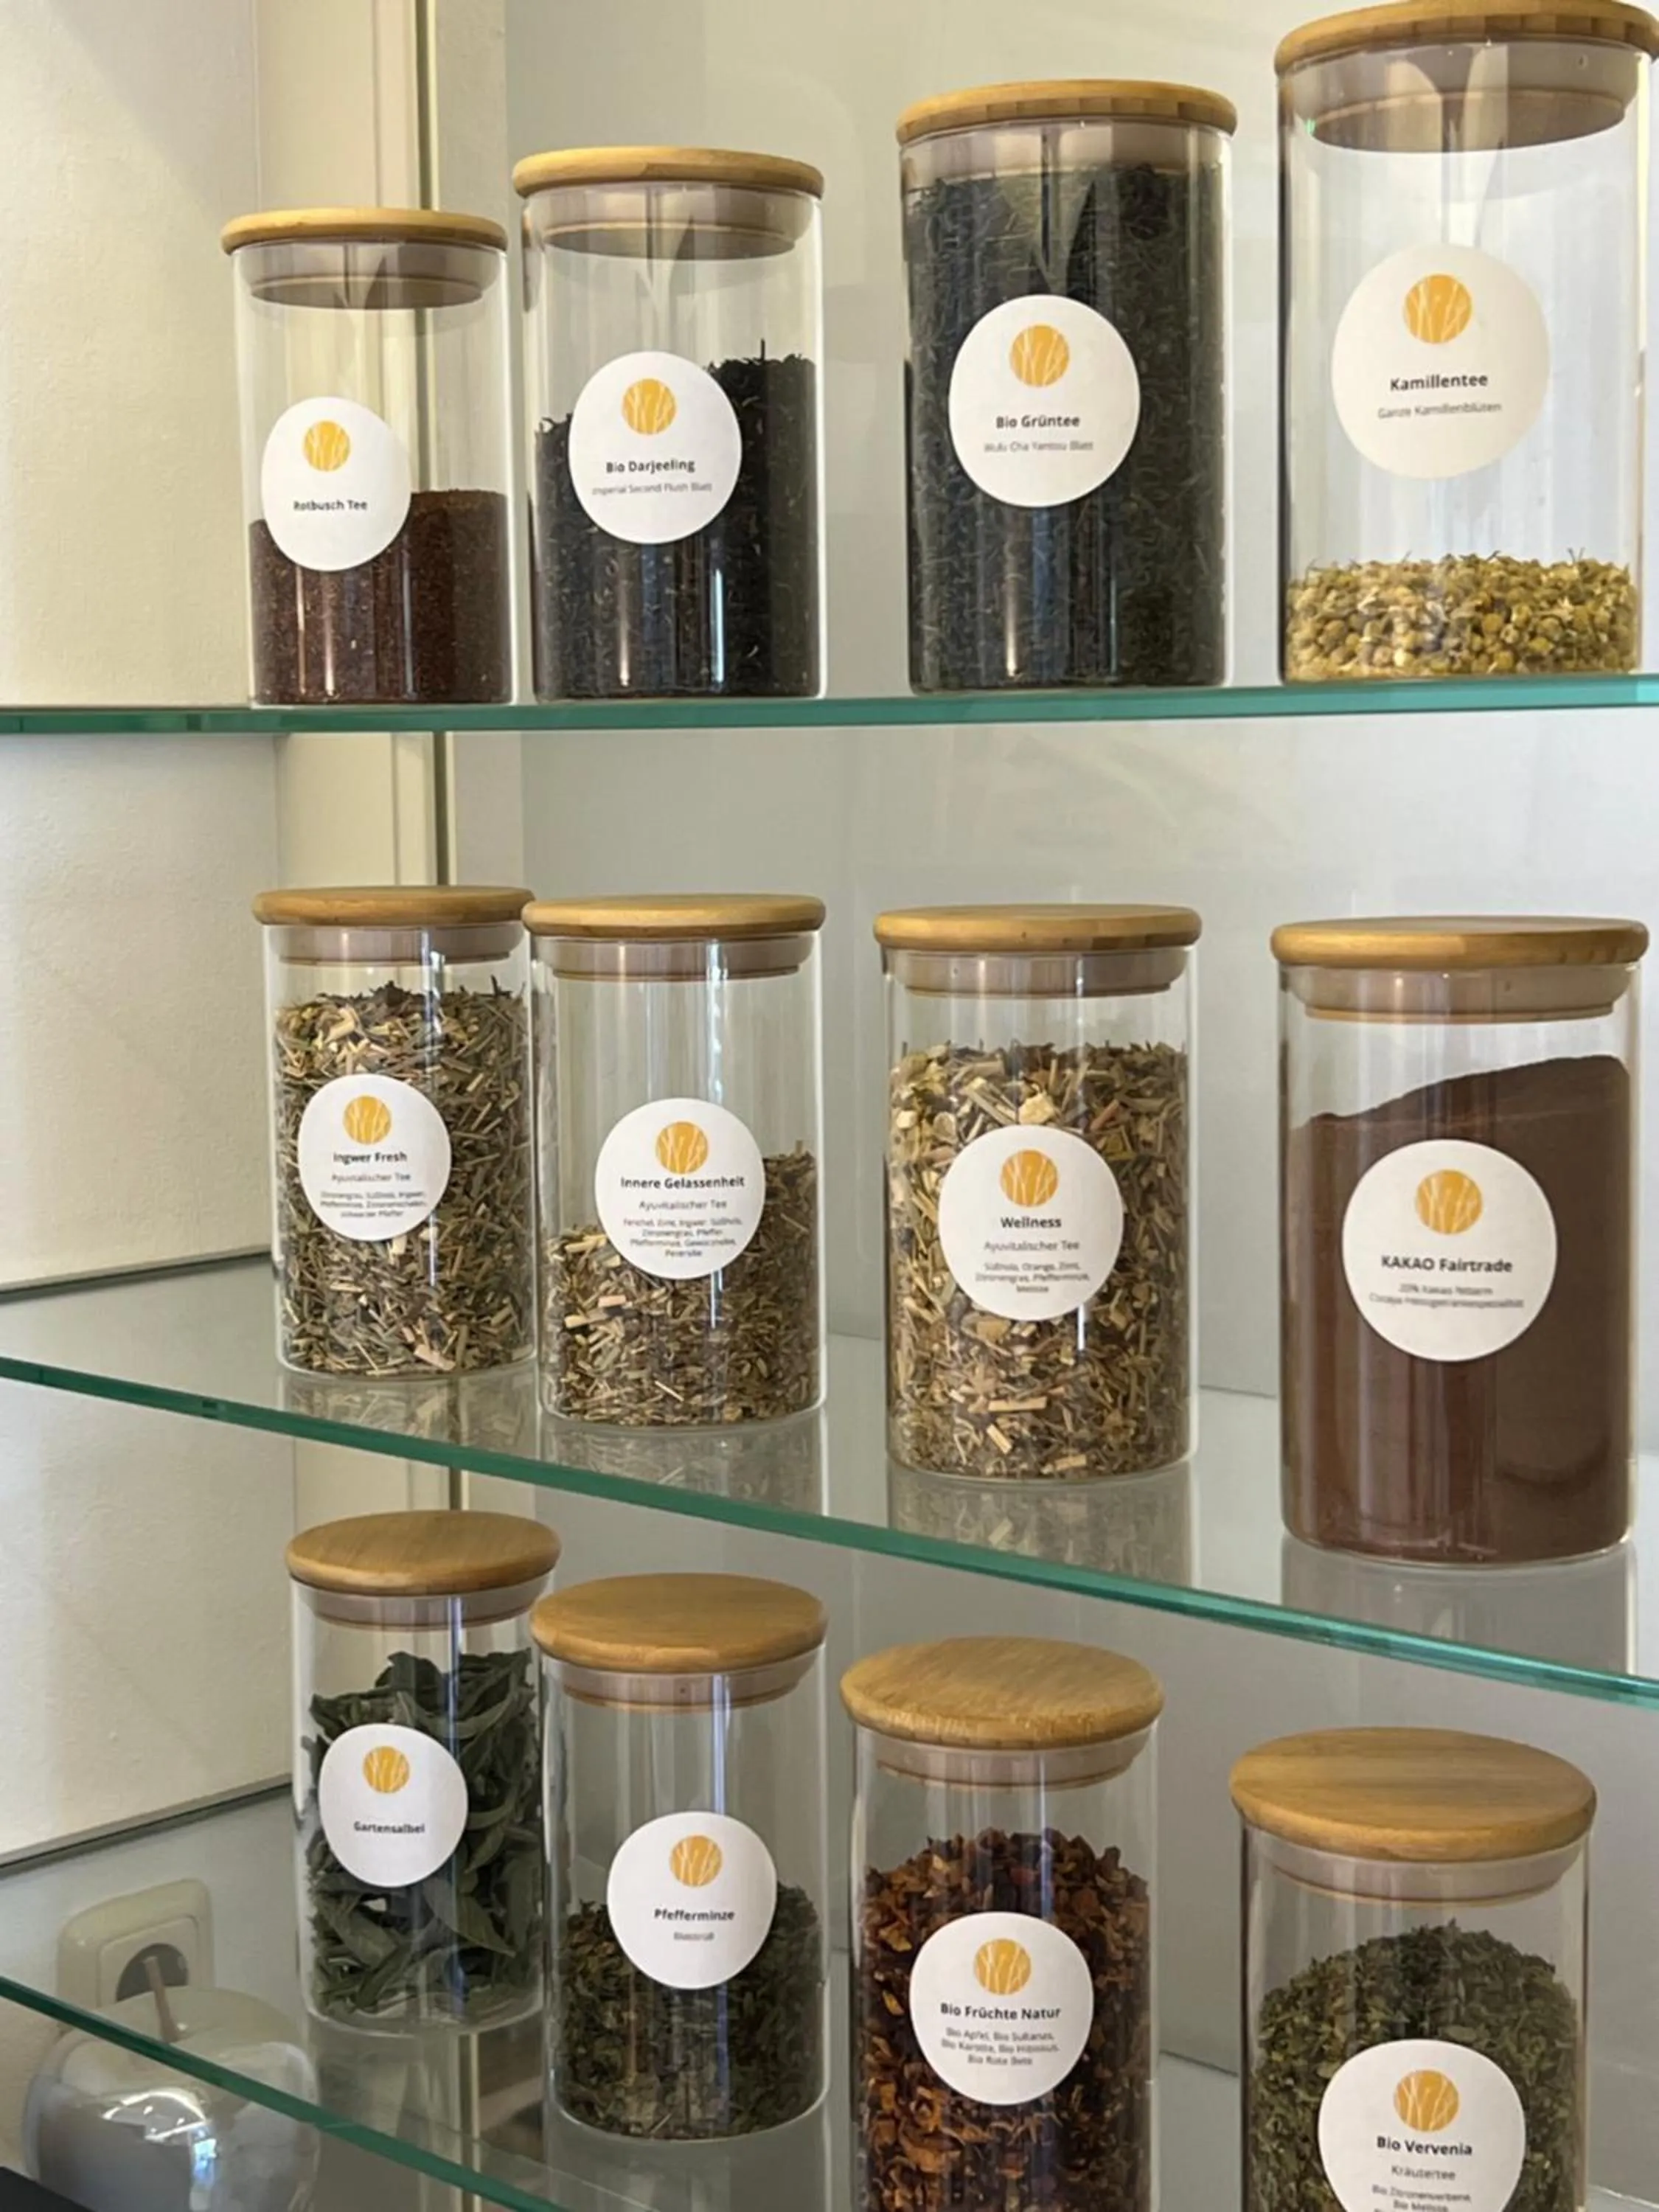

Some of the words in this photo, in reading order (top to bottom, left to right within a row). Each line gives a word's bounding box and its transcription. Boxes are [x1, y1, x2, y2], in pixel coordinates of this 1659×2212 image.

[1390, 374, 1489, 392] Kamillentee
[1414, 402, 1502, 416] Kamillenblüten
[996, 416, 1018, 428] Bio
[1021, 414, 1080, 428] Grüntee
[606, 462, 625, 473] Bio
[628, 459, 695, 474] Darjeeling
[628, 483, 662, 493] Second
[664, 482, 689, 493] Flush
[293, 500, 344, 511] Rotbusch
[347, 499, 367, 510] Tee
[333, 1152, 370, 1166] Ingwer
[375, 1151, 408, 1163] Fresh
[395, 1172, 411, 1180] Tee
[620, 1176, 661, 1189] Innere
[664, 1175, 745, 1189] Gelassenheit
[711, 1200, 727, 1209] Tee
[1001, 1217, 1062, 1228] Wellness
[1060, 1240, 1079, 1251] Tee
[1381, 1256, 1435, 1270] KAKAO
[1439, 1258, 1513, 1273] Fairtrade
[354, 1820, 425, 1834] Gartensalbei
[654, 1908, 734, 1921] Pfefferminze
[940, 2003, 961, 2015] Bio
[965, 2006, 1018, 2020] Früchte
[1021, 2008, 1061, 2020] Natur
[946, 2027, 961, 2037] Bio
[993, 2031, 1009, 2041] Bio
[941, 2038, 956, 2048] Bio
[998, 2043, 1015, 2053] Bio
[967, 2054, 984, 2064] Bio
[1377, 2136, 1401, 2151] Bio
[1405, 2139, 1473, 2155] Vervenia
[1391, 2165, 1455, 2180] Kräutertee
[1371, 2184, 1388, 2195] Bio
[1394, 2199, 1408, 2211] Bio
